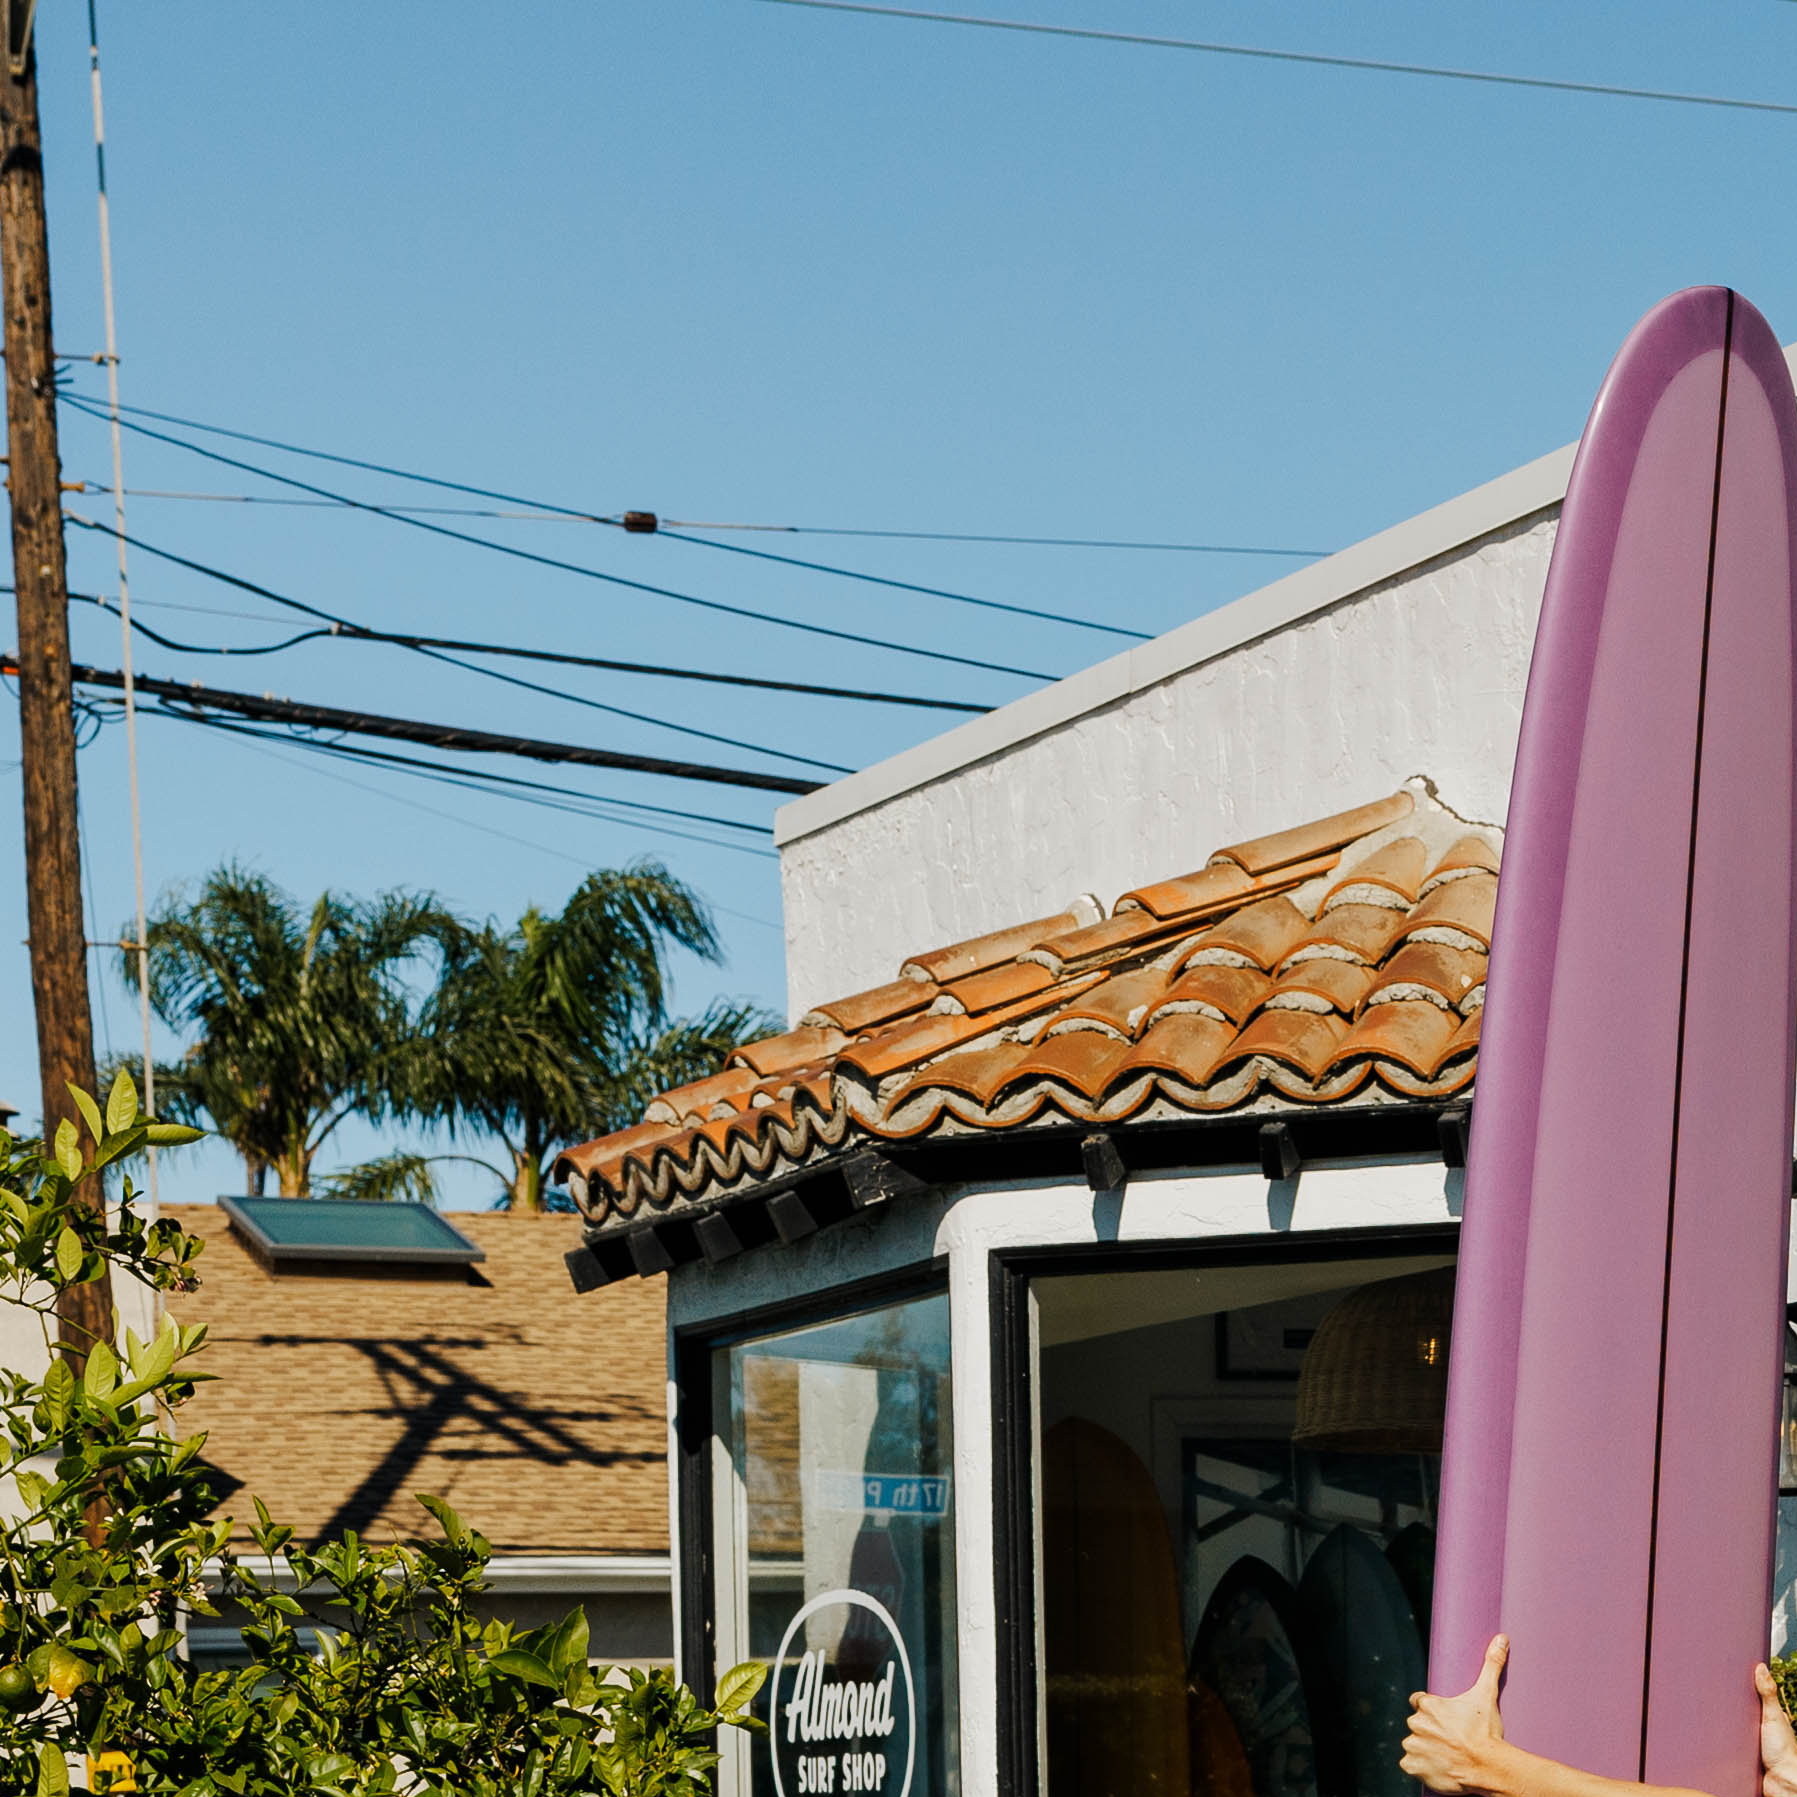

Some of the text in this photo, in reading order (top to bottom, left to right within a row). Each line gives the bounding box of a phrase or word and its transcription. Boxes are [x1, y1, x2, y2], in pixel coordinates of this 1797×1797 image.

[785, 1648, 895, 1744] Almond
[798, 1751, 886, 1794] SURF SHOP
